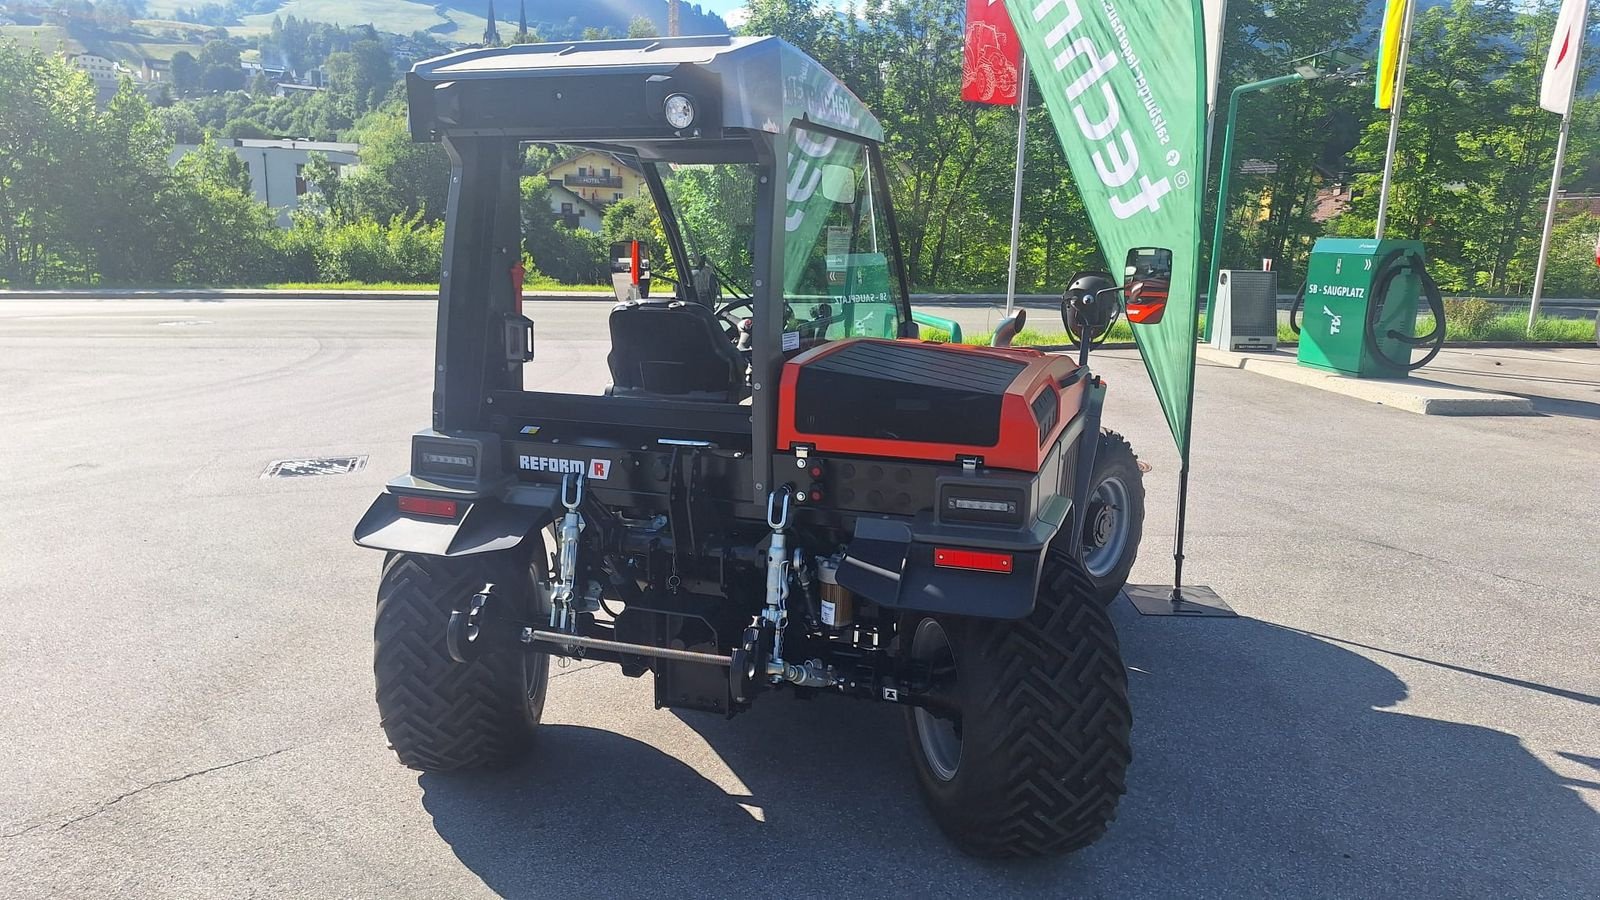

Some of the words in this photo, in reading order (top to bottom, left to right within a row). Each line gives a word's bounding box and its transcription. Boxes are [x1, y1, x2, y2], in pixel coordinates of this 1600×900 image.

[1309, 284, 1318, 294] SB
[1323, 285, 1365, 298] SAUGPLATZ
[520, 455, 585, 475] REFORM
